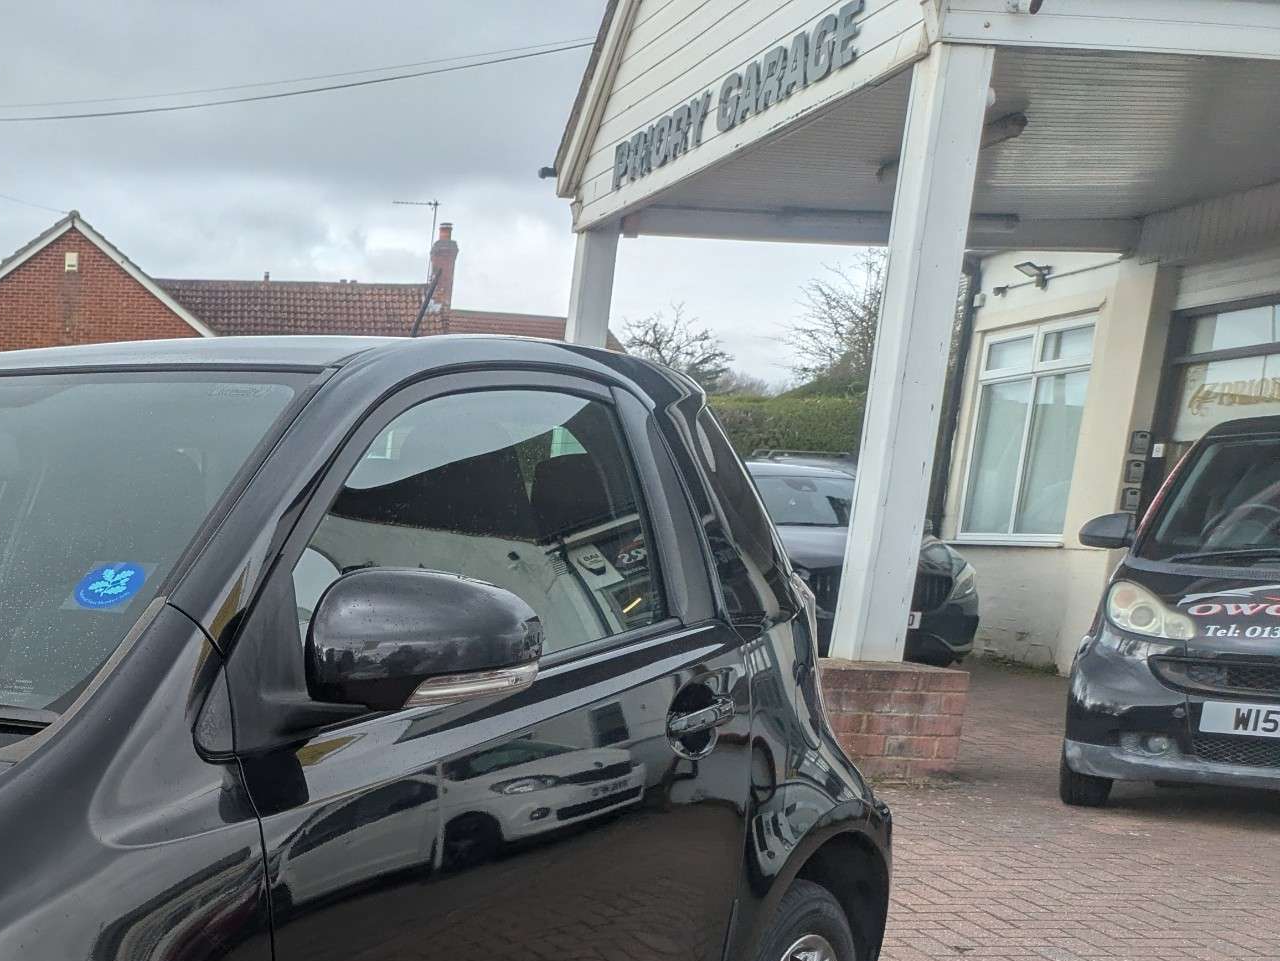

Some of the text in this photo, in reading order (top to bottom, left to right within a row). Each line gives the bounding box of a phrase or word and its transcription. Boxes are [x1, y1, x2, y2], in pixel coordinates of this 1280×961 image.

[613, 0, 865, 190] PRIORY GARAGE
[1205, 624, 1240, 637] Tel:
